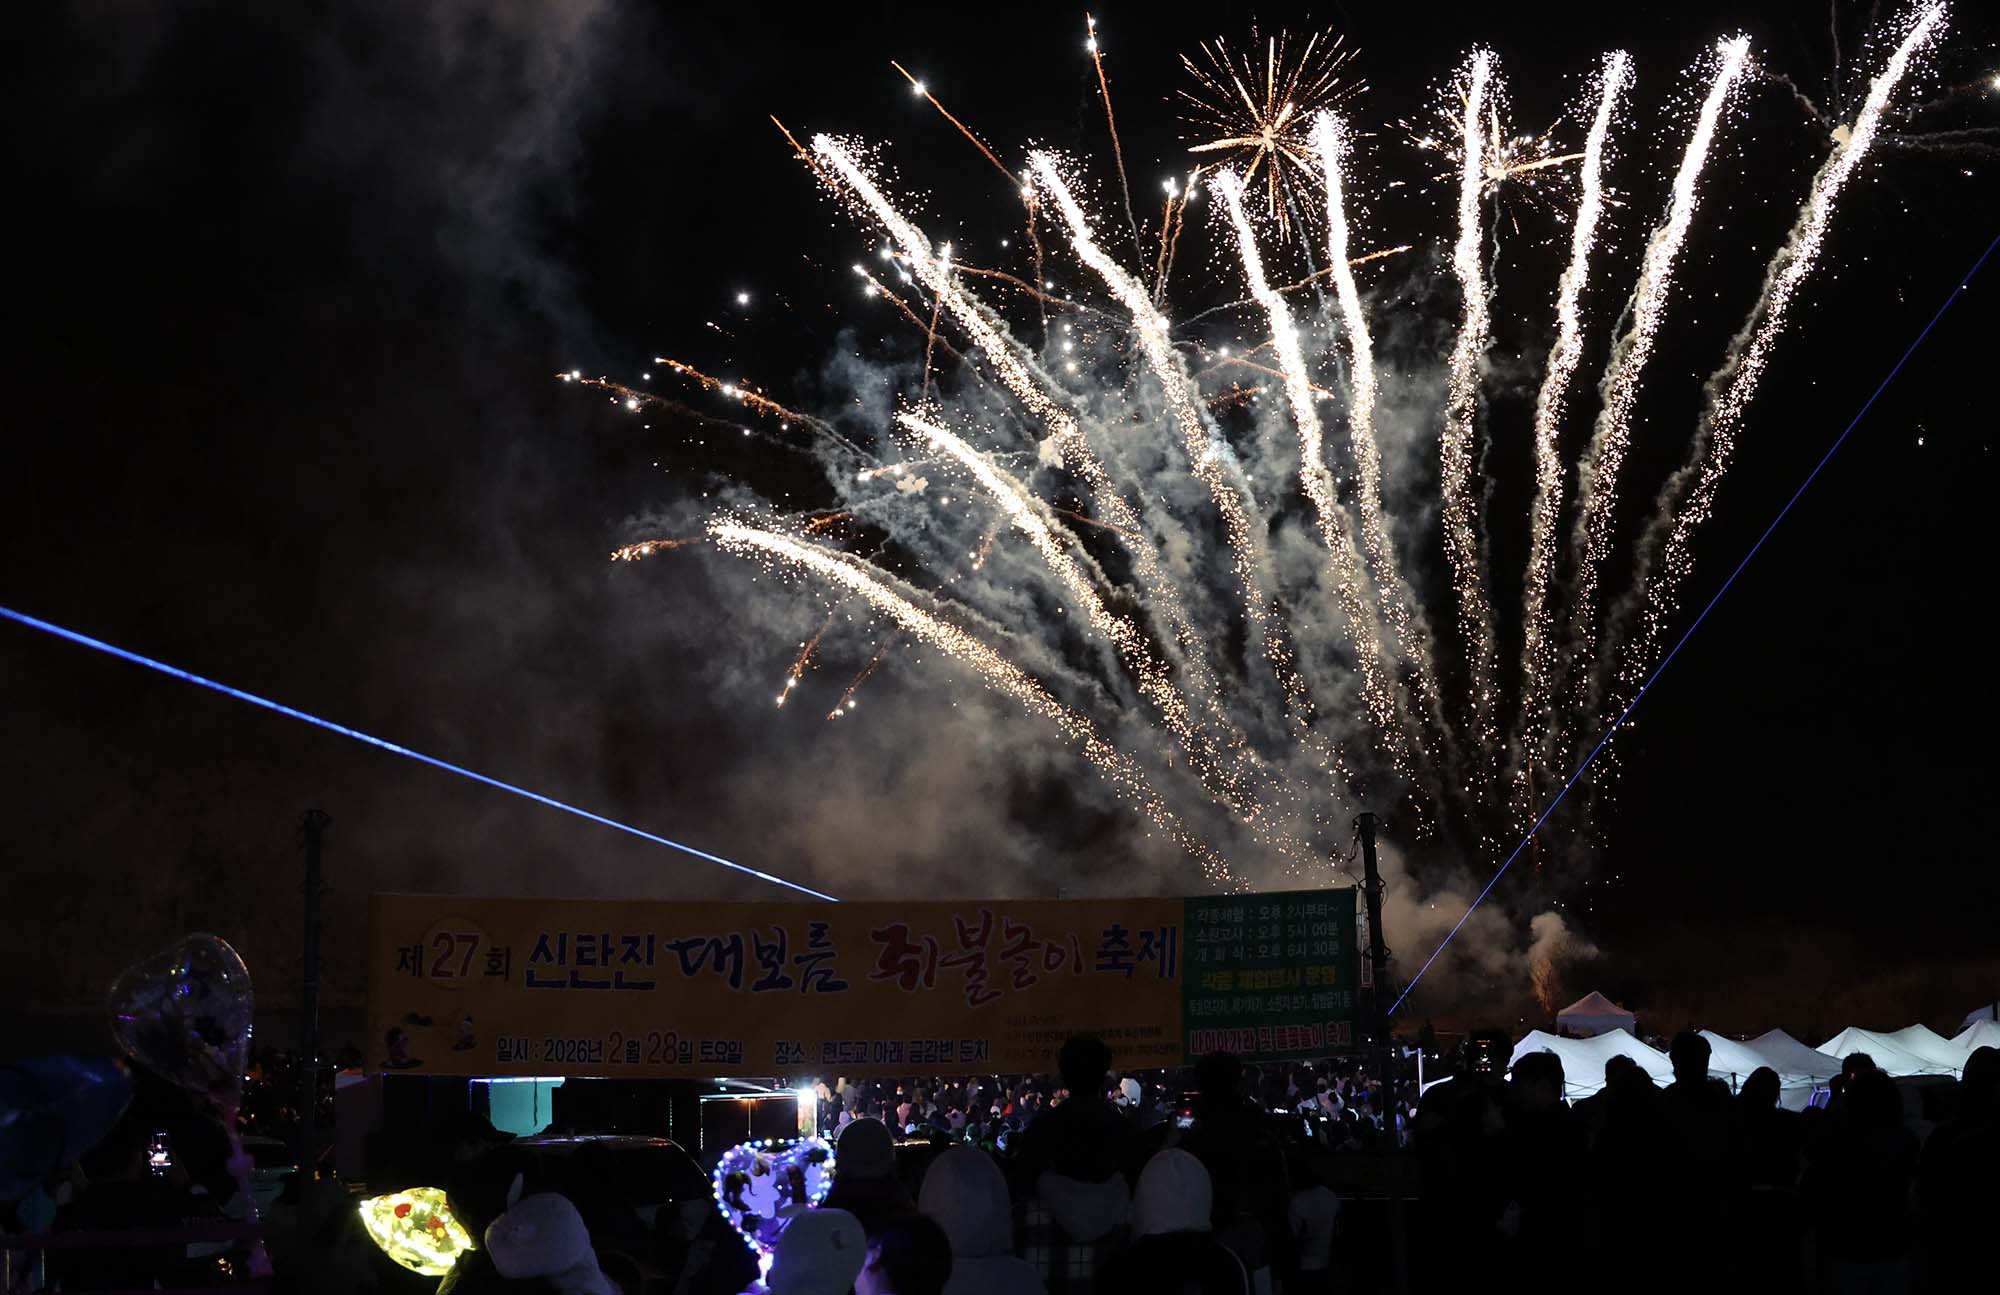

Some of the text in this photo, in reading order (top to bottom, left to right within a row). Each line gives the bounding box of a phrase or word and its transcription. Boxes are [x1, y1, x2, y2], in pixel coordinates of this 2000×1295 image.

[1288, 924, 1306, 940] 5시
[525, 932, 656, 990] 신탄진
[664, 921, 849, 993] 대보름
[868, 908, 1086, 1007] 쥐불놀이
[1095, 924, 1177, 979] 축제
[1288, 943, 1306, 959] 6시
[495, 1037, 529, 1063] 일시
[544, 1038, 603, 1065] 2026년
[608, 1031, 641, 1065] 2월
[646, 1031, 693, 1065] 28일
[699, 1039, 743, 1065] 토요일
[775, 1041, 806, 1066] 장소
[822, 1040, 868, 1065] 현도교
[873, 1041, 905, 1065] 아래
[908, 1041, 954, 1064] 금강변
[959, 1040, 990, 1063] 둔치
